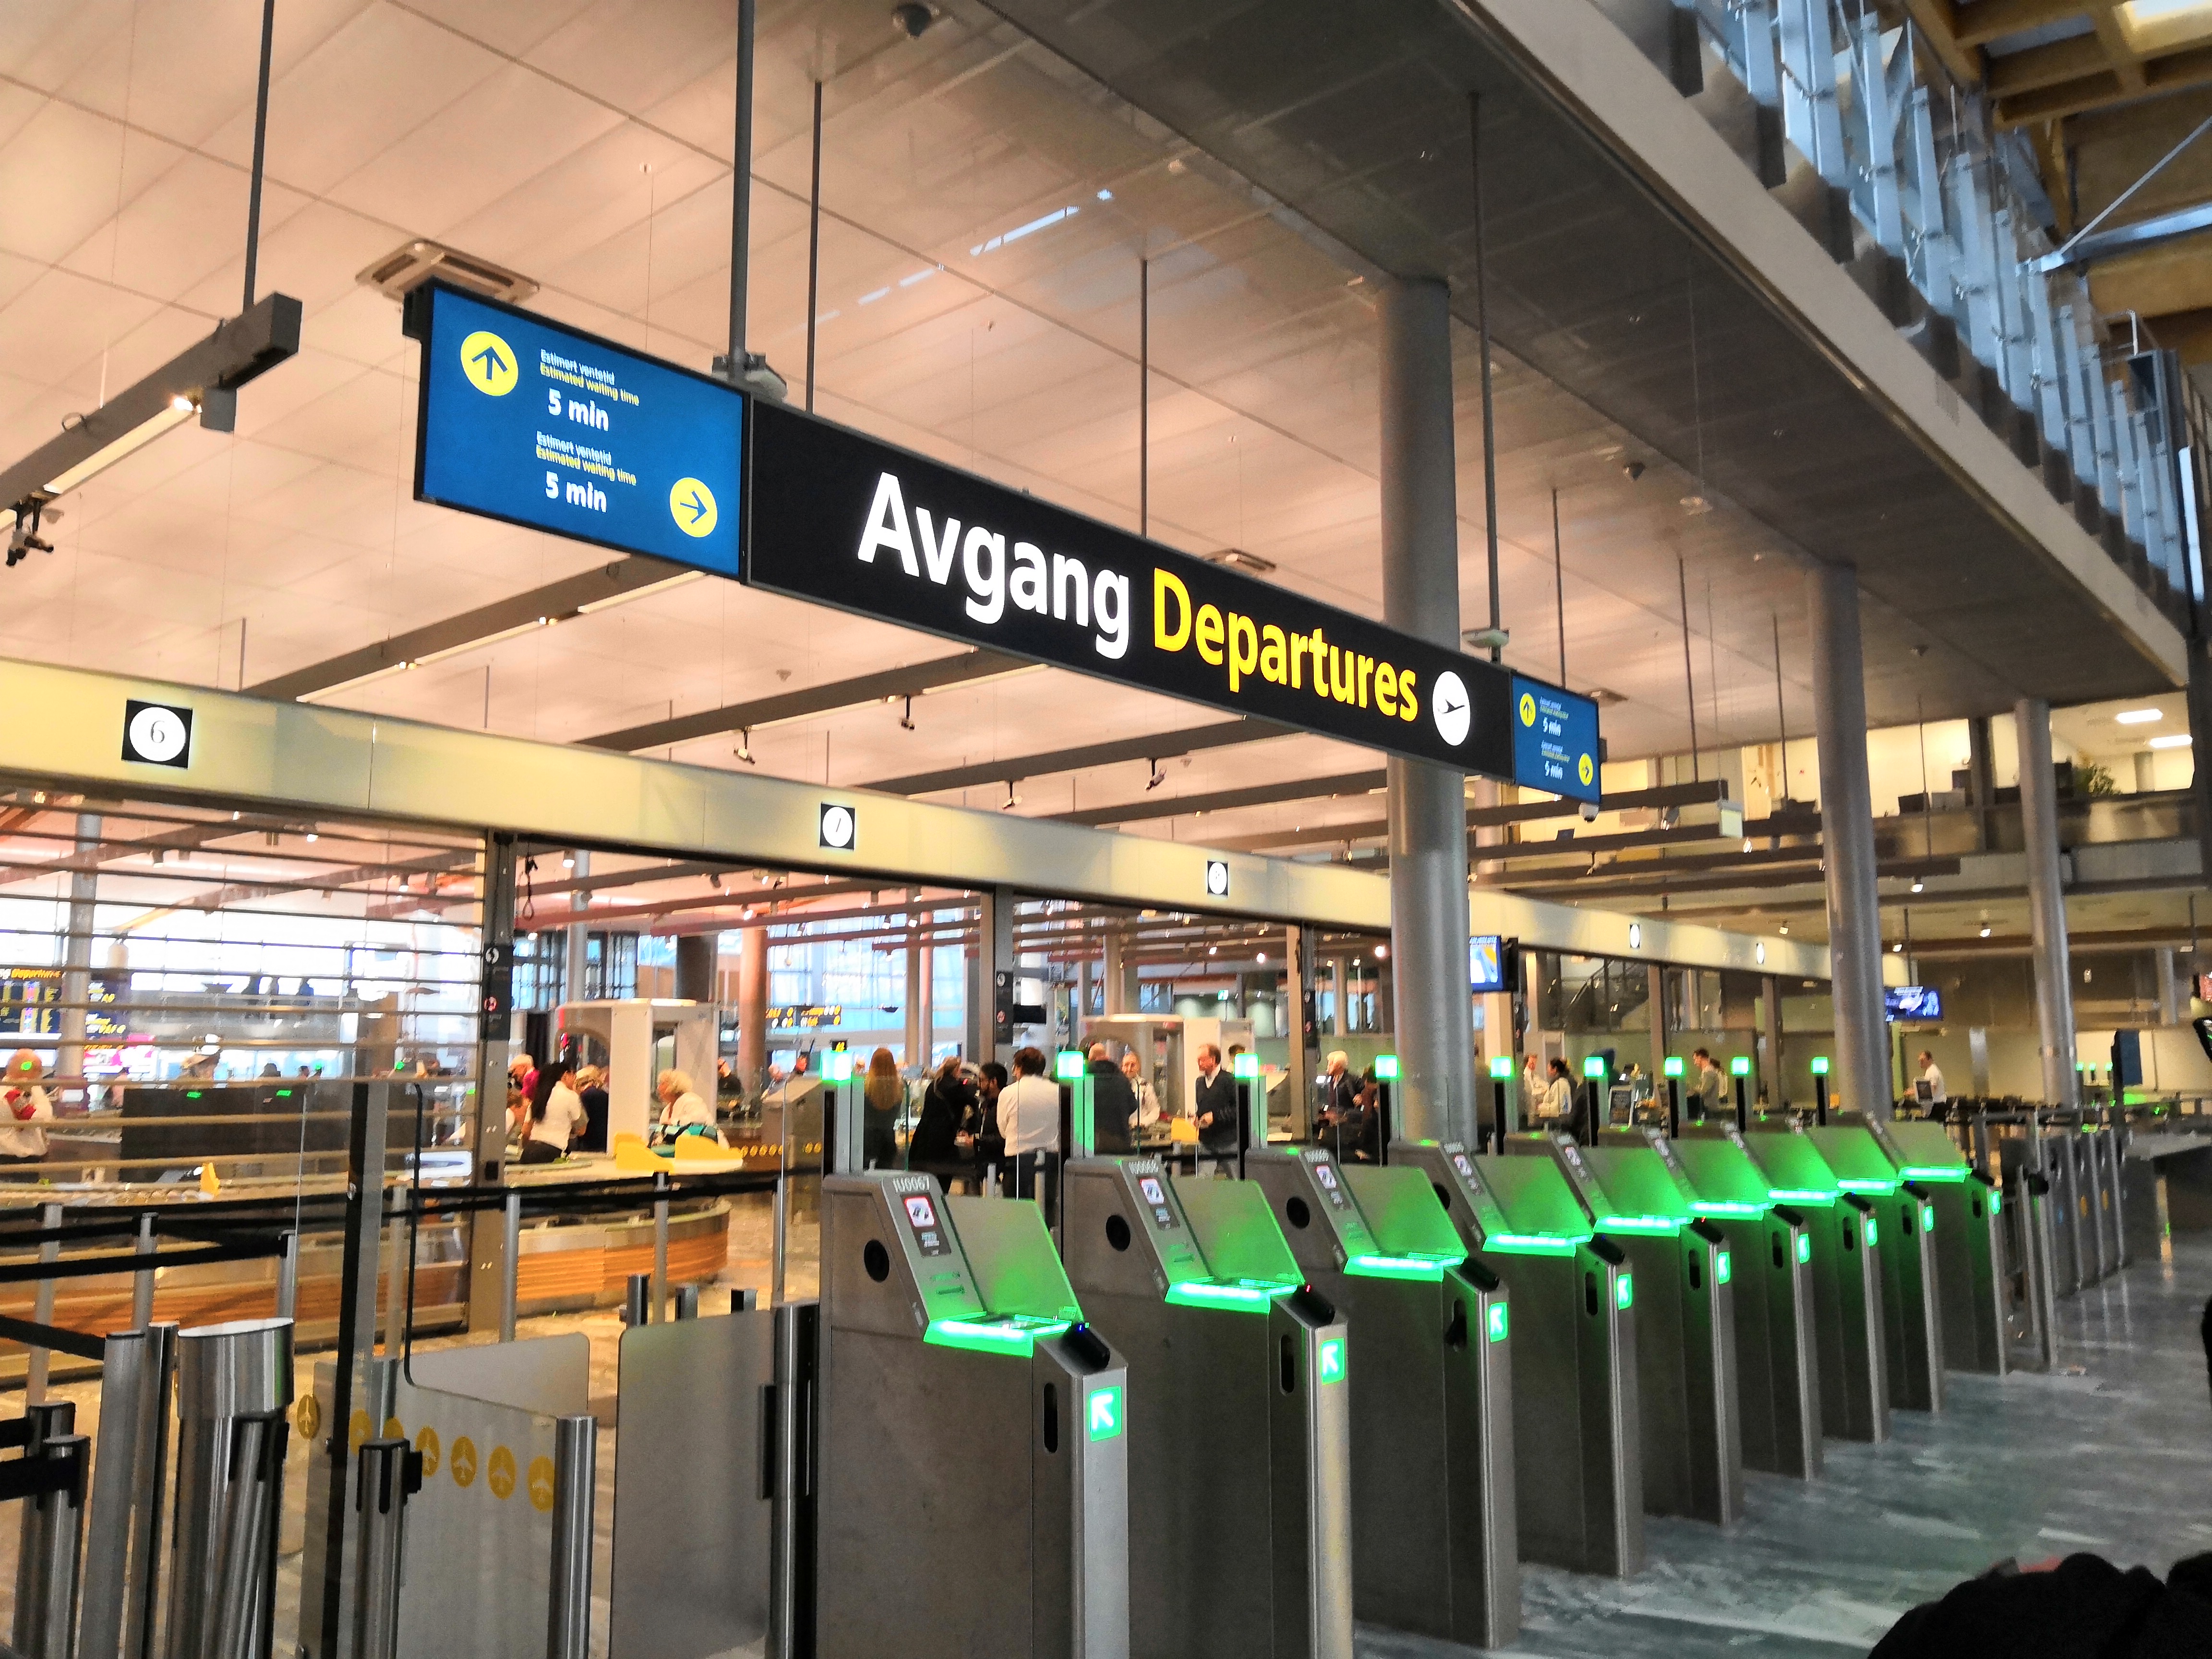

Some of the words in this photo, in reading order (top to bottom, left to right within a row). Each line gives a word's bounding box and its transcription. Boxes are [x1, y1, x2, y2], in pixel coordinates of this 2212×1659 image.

[540, 361, 584, 388] Estimated
[585, 378, 618, 401] waiting
[620, 388, 639, 406] time
[548, 388, 562, 416] 5
[569, 399, 609, 432] min
[536, 444, 580, 469] Estimated
[582, 459, 615, 481] waiting
[617, 468, 637, 486] time
[545, 471, 559, 499] 5
[566, 481, 607, 513] min
[857, 471, 1129, 659] Avgang
[1154, 567, 1418, 721] Departures
[150, 721, 165, 743] 6
